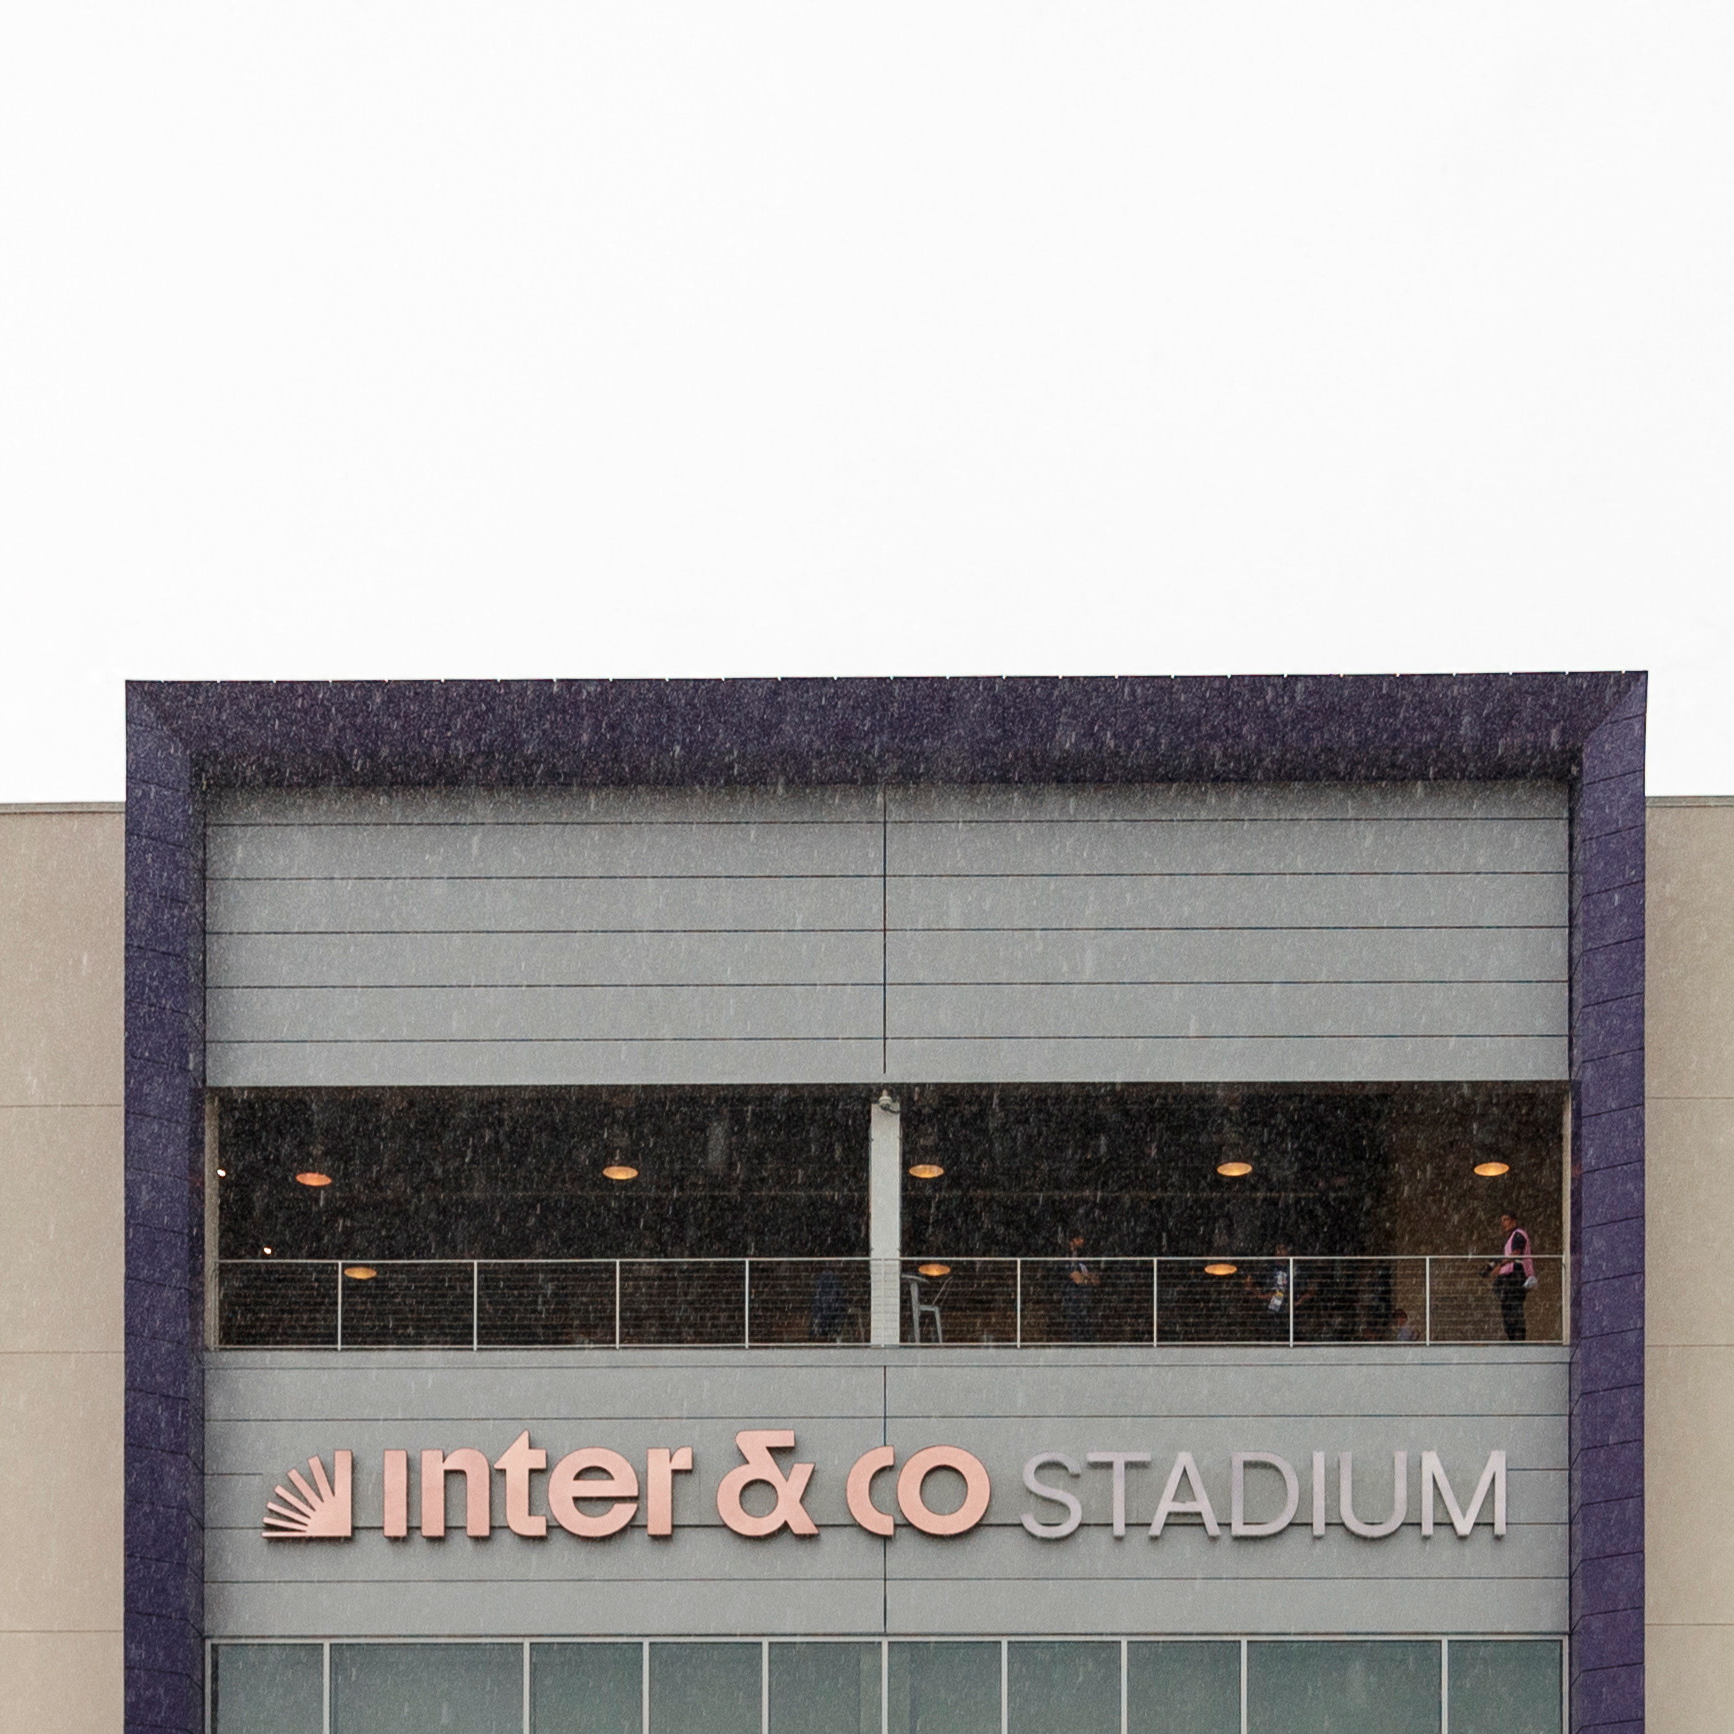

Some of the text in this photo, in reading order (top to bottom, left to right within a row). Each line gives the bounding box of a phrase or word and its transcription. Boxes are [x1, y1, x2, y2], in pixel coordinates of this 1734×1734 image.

[715, 1429, 822, 1538] &
[844, 1444, 992, 1538] co
[1019, 1449, 1507, 1541] STADIUM
